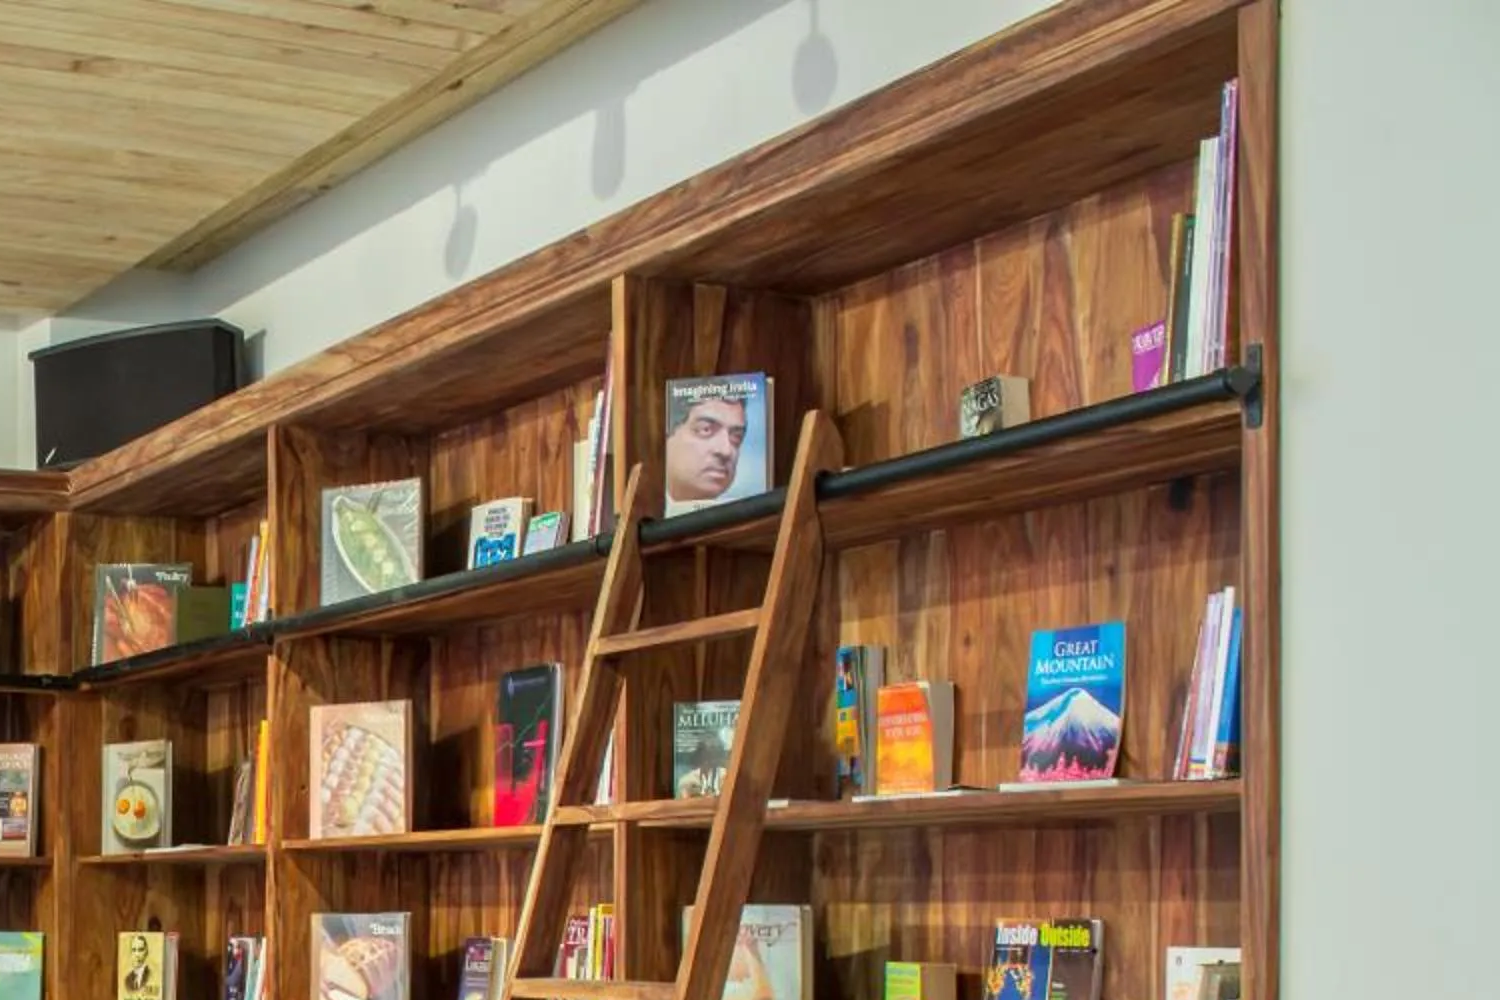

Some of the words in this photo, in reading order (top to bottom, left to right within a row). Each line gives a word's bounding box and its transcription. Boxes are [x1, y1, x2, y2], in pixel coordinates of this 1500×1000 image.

[1054, 639, 1098, 657] GREAT
[1035, 652, 1115, 675] MOUNTAIN
[996, 922, 1038, 945] Inside
[1040, 923, 1090, 947] Outside
